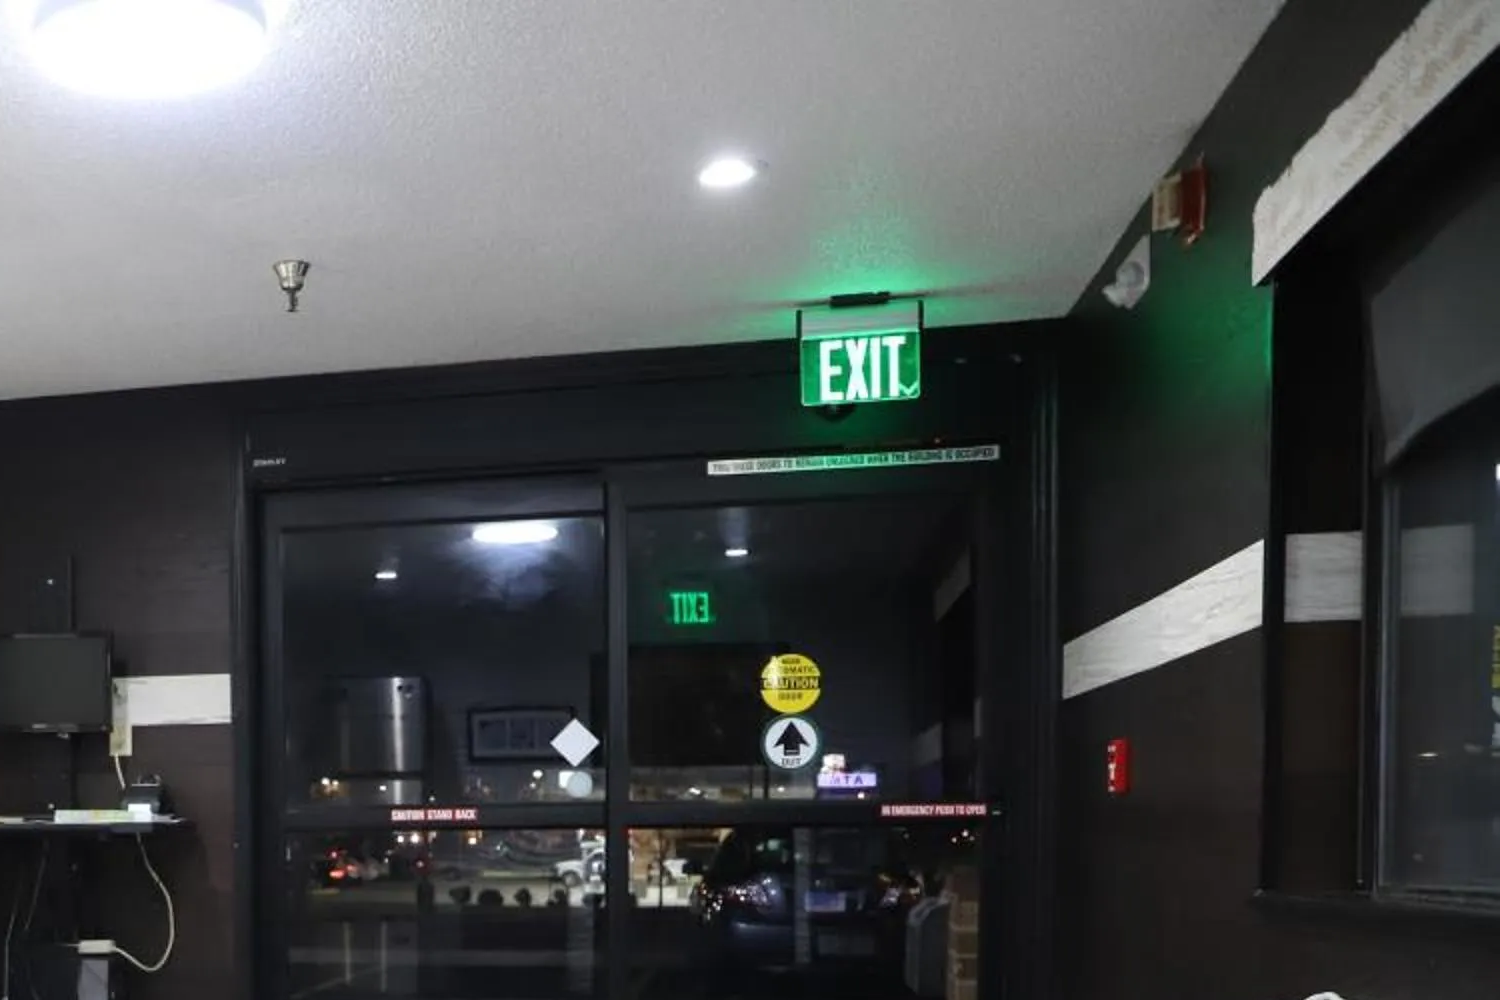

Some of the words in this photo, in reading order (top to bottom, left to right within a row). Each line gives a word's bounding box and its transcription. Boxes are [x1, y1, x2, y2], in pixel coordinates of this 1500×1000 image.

[820, 335, 906, 401] EXIT
[763, 677, 819, 689] CUTION
[427, 808, 453, 820] STAND
[455, 807, 477, 820] BACK
